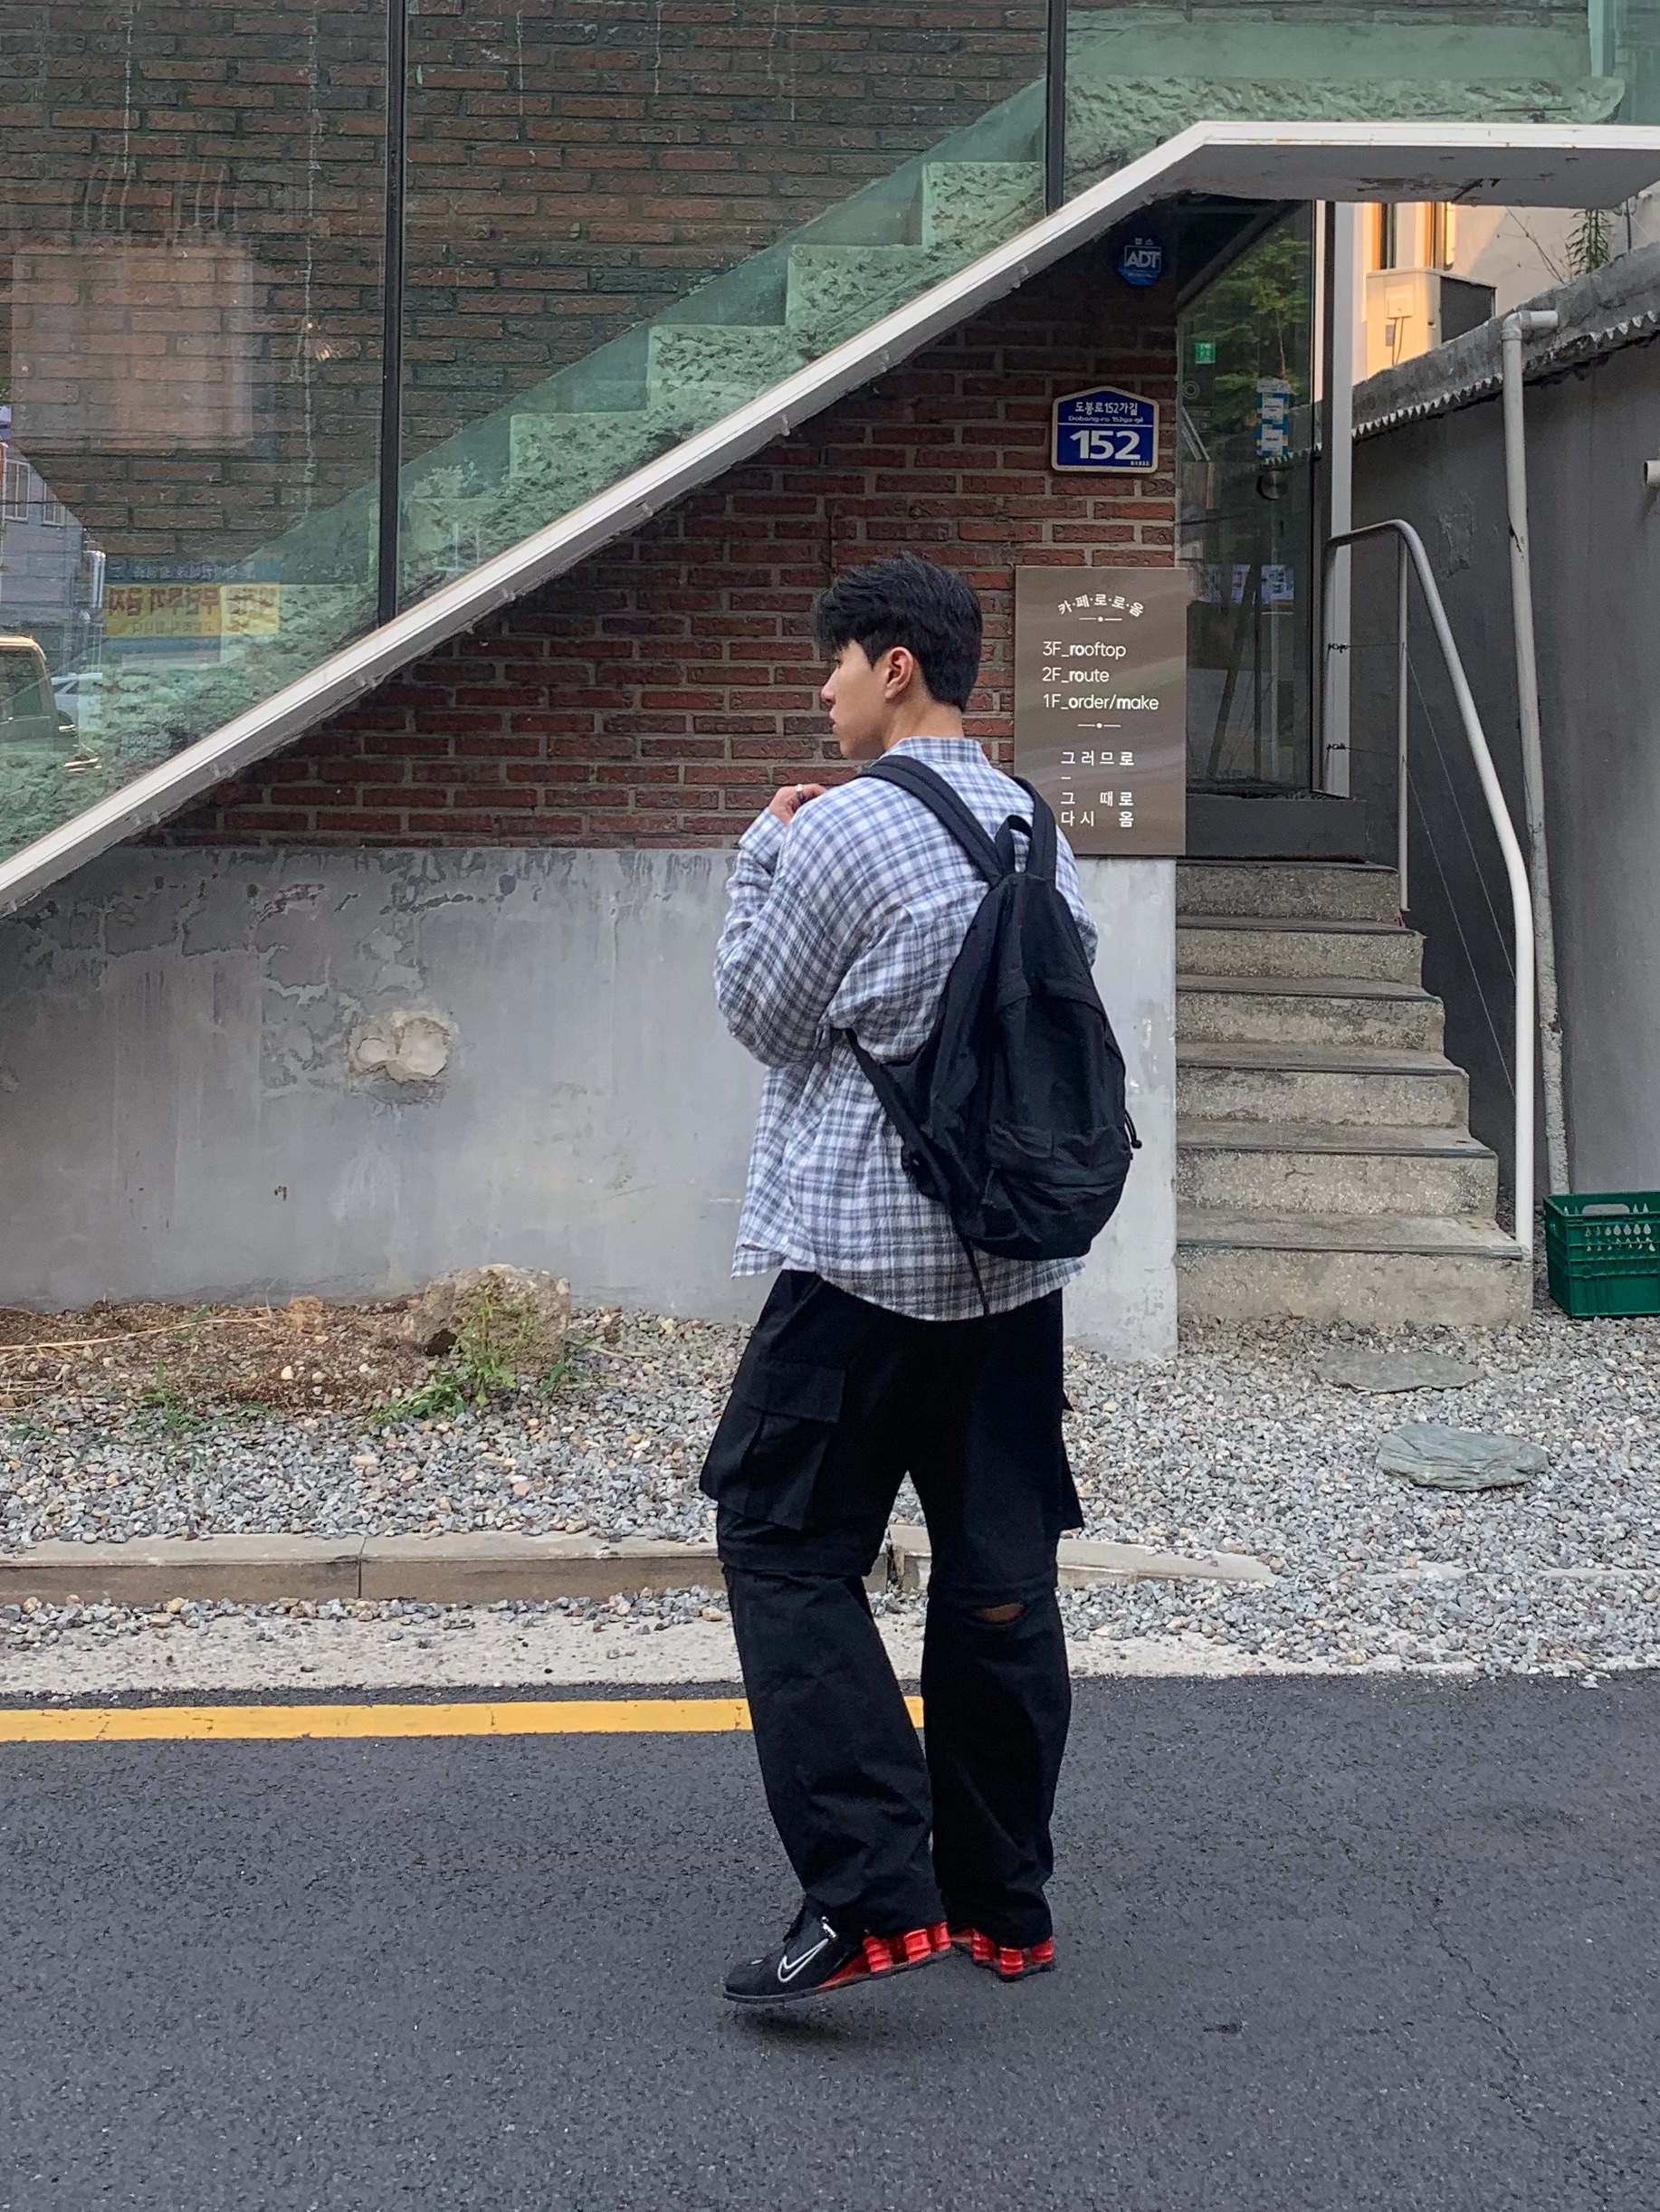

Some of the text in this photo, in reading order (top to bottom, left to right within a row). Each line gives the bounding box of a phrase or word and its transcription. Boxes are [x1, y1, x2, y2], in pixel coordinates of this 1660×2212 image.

[1124, 250, 1161, 268] ADT
[1075, 401, 1138, 416] 도봉로152가길
[1069, 429, 1141, 461] 152
[1042, 641, 1127, 661] 3F_rooftop
[1042, 666, 1110, 683] 2F_route
[1043, 693, 1159, 710] 1F_order/make
[1060, 791, 1076, 805] 그
[1061, 810, 1134, 828] 다시 옴
